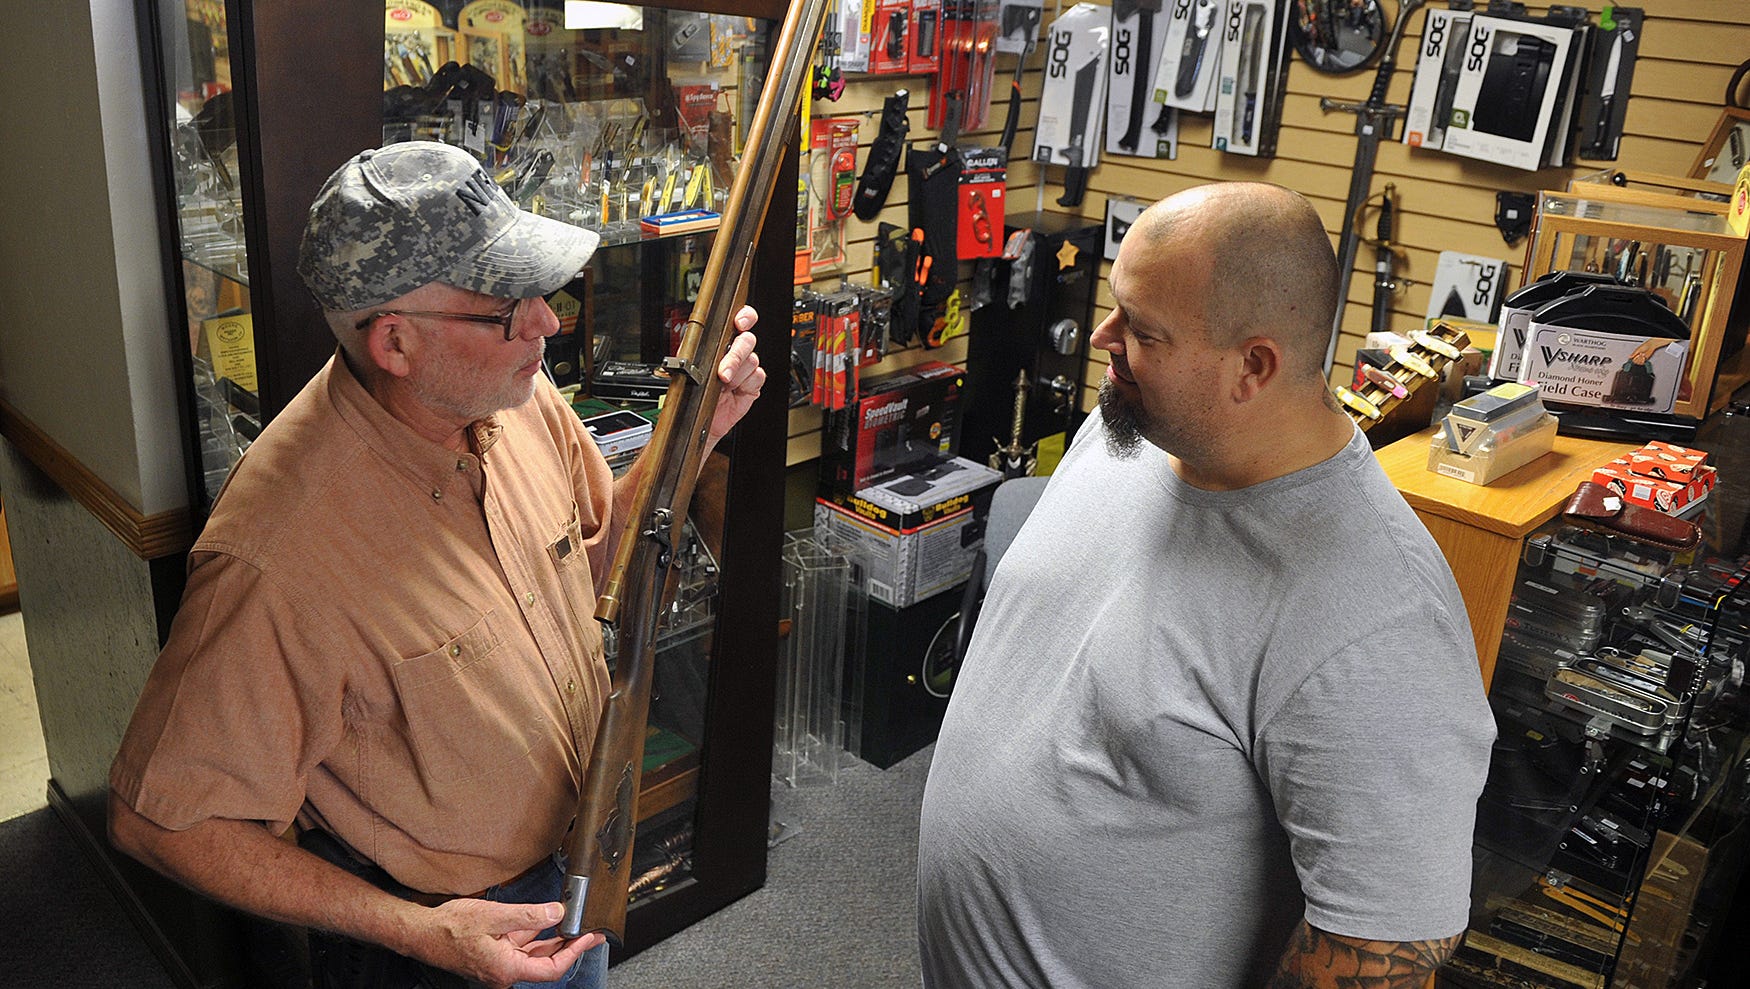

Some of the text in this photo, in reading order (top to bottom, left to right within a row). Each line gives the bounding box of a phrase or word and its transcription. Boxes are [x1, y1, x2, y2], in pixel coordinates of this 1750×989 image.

[1228, 2, 1243, 41] SOG
[1426, 16, 1446, 57] SOG
[1050, 31, 1072, 78] SOG
[1114, 29, 1131, 75] SOG
[1468, 27, 1490, 72] SOG
[1473, 265, 1496, 306] SOG
[1538, 371, 1603, 386] Diamond Honer
[1571, 385, 1602, 399] Case
[935, 494, 969, 512] Bulldog
